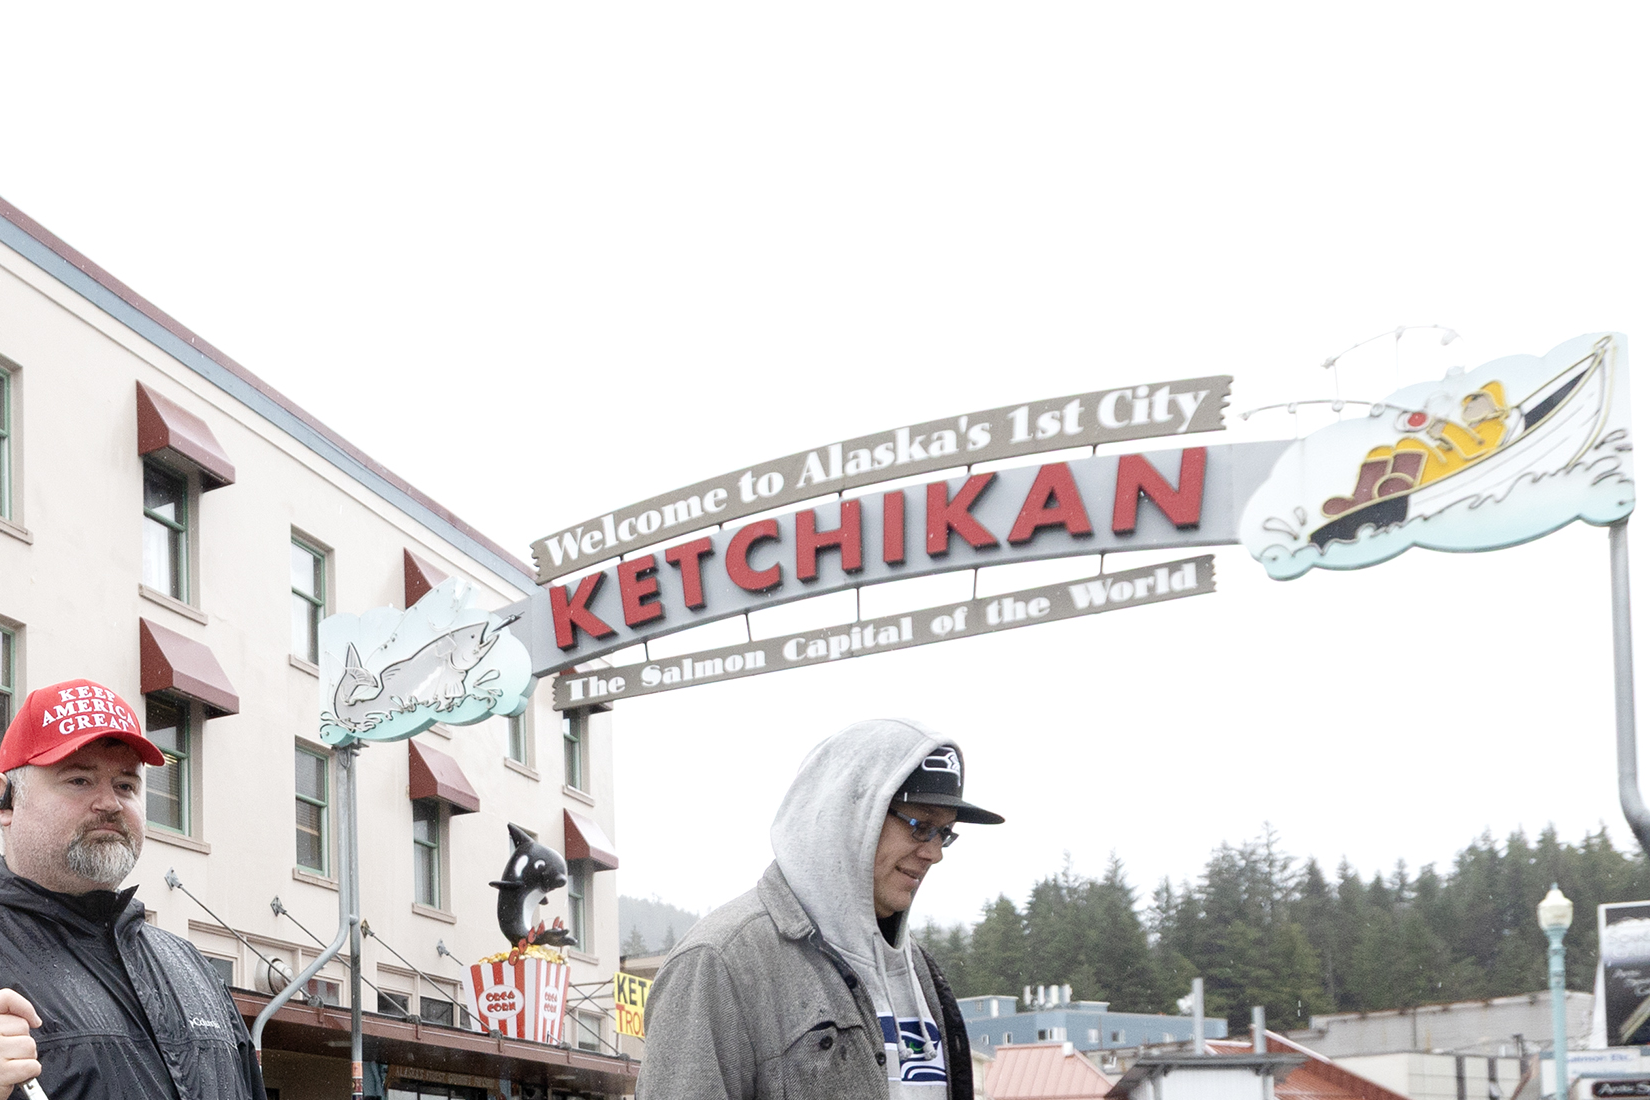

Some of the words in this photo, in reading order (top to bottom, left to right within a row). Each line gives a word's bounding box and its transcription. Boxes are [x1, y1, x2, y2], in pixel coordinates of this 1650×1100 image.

[546, 487, 728, 566] Welcome
[739, 470, 785, 504] to
[797, 416, 992, 488] Alaska's
[1006, 399, 1084, 444] 1st
[1097, 385, 1210, 432] City
[549, 446, 1207, 651] KETCHIKAN
[566, 674, 626, 701] The
[641, 649, 767, 687] Salmon
[783, 617, 914, 660] Capital
[930, 606, 968, 636] of
[986, 595, 1051, 626] the
[1068, 562, 1198, 609] World
[58, 686, 115, 702] KEEP
[42, 699, 136, 727] AMERICA
[58, 714, 128, 735] GREAT
[485, 990, 516, 1002] ORCA
[616, 974, 652, 1008] KET
[486, 1002, 516, 1013] CORN
